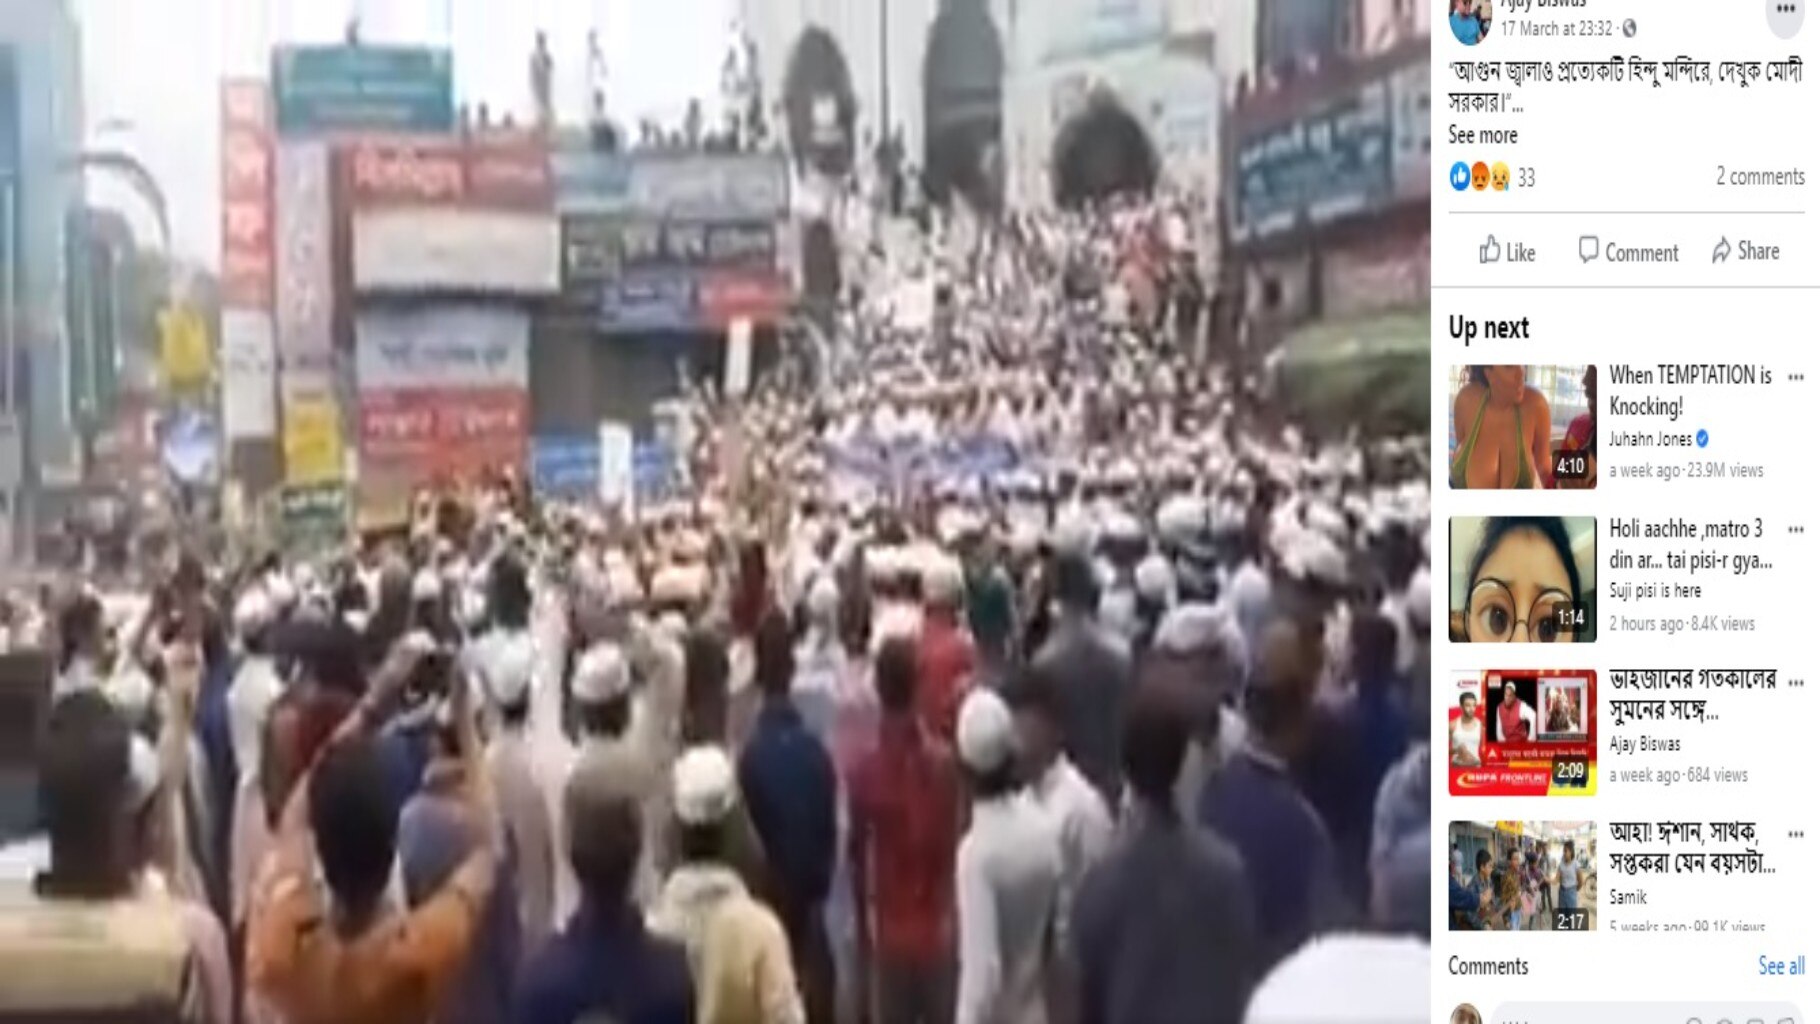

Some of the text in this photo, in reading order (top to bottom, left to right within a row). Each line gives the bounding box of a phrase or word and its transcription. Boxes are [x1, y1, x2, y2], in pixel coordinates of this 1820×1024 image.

[1502, 20, 1612, 36] 17 March at 23:32
[1505, 60, 1554, 87] জ্বালাও
[1558, 55, 1624, 83] প্রত্যেকটি
[1628, 55, 1661, 88] হিন্দু
[1662, 55, 1713, 86] মন্দিরে,
[1719, 60, 1762, 88] দেখুক
[1766, 55, 1805, 83] মোদী
[1448, 124, 1518, 144] See more
[1518, 167, 1536, 187] 33
[1717, 165, 1805, 185] 2 comments
[1507, 242, 1536, 262] Like
[1606, 242, 1679, 262] Comment
[1738, 240, 1780, 260] Share
[1449, 314, 1529, 347] Up next
[1609, 364, 1772, 384] When TEMPTATION is
[1610, 395, 1683, 421] Knocking!
[1609, 431, 1692, 447] Juhahn Jones
[1557, 457, 1584, 473] 4:10
[1610, 466, 1616, 478] a
[1621, 461, 1653, 478] week
[1730, 462, 1763, 478] views
[1610, 517, 1763, 542] Holi aachhe ,matro 3
[1610, 549, 1772, 575] din ar... tai pisi-r gya...
[1610, 581, 1701, 602] Suji pisi is here
[1558, 609, 1585, 625] 1:14
[1610, 615, 1617, 631] 2
[1622, 615, 1656, 631] hours
[1721, 615, 1755, 631] views
[1698, 669, 1778, 690] গতকালের
[1609, 700, 1666, 726] সুমনের
[1609, 735, 1636, 755] Ajay
[1640, 735, 1681, 751] Biswas
[1557, 762, 1584, 778] 2:09
[1610, 771, 1616, 783] a
[1621, 766, 1653, 783] week
[1714, 767, 1748, 783] views
[1609, 822, 1652, 843] আহা!
[1675, 853, 1706, 875] যেন
[1610, 888, 1647, 905] Samik
[1557, 913, 1585, 930] 2:17
[1448, 955, 1529, 975] Comments
[1759, 955, 1806, 975] See all
